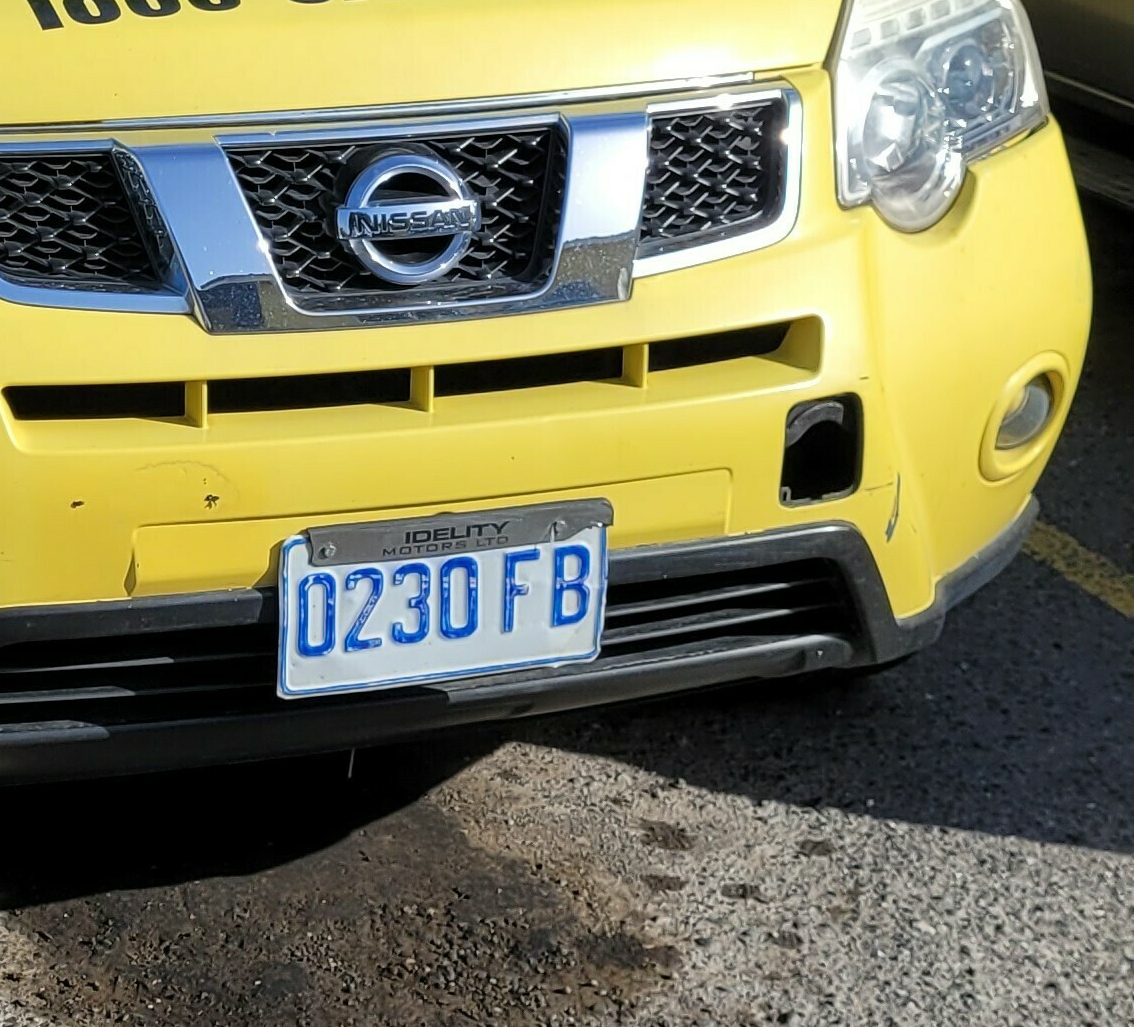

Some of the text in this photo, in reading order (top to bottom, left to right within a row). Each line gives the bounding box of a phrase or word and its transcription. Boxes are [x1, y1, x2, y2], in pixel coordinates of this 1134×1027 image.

[348, 206, 472, 236] NISSAN
[382, 536, 509, 557] MOTORS LTD
[297, 556, 479, 657] 0230
